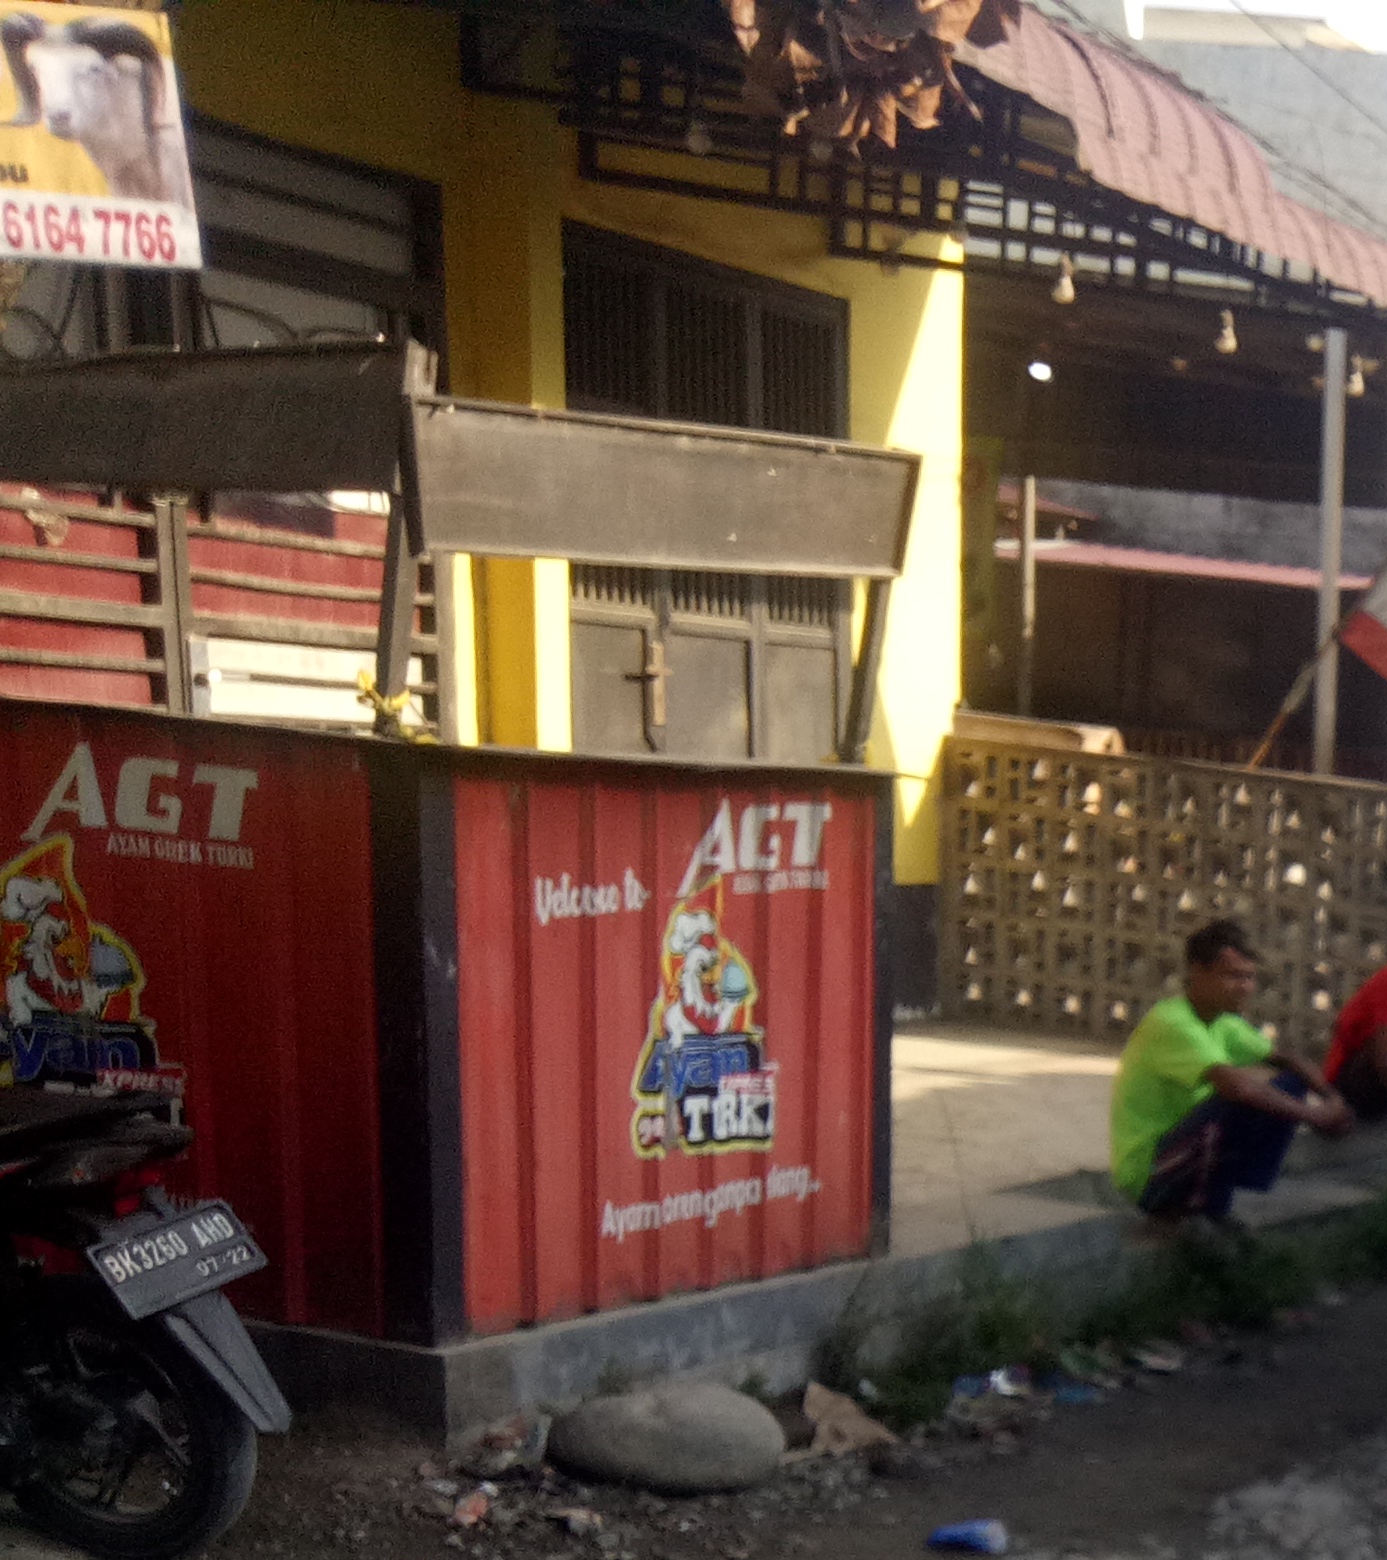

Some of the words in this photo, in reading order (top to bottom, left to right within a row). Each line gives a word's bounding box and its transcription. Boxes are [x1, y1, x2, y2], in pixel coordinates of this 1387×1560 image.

[93, 209, 177, 263] 7766
[20, 740, 260, 843] AGT
[676, 798, 833, 898] AGT
